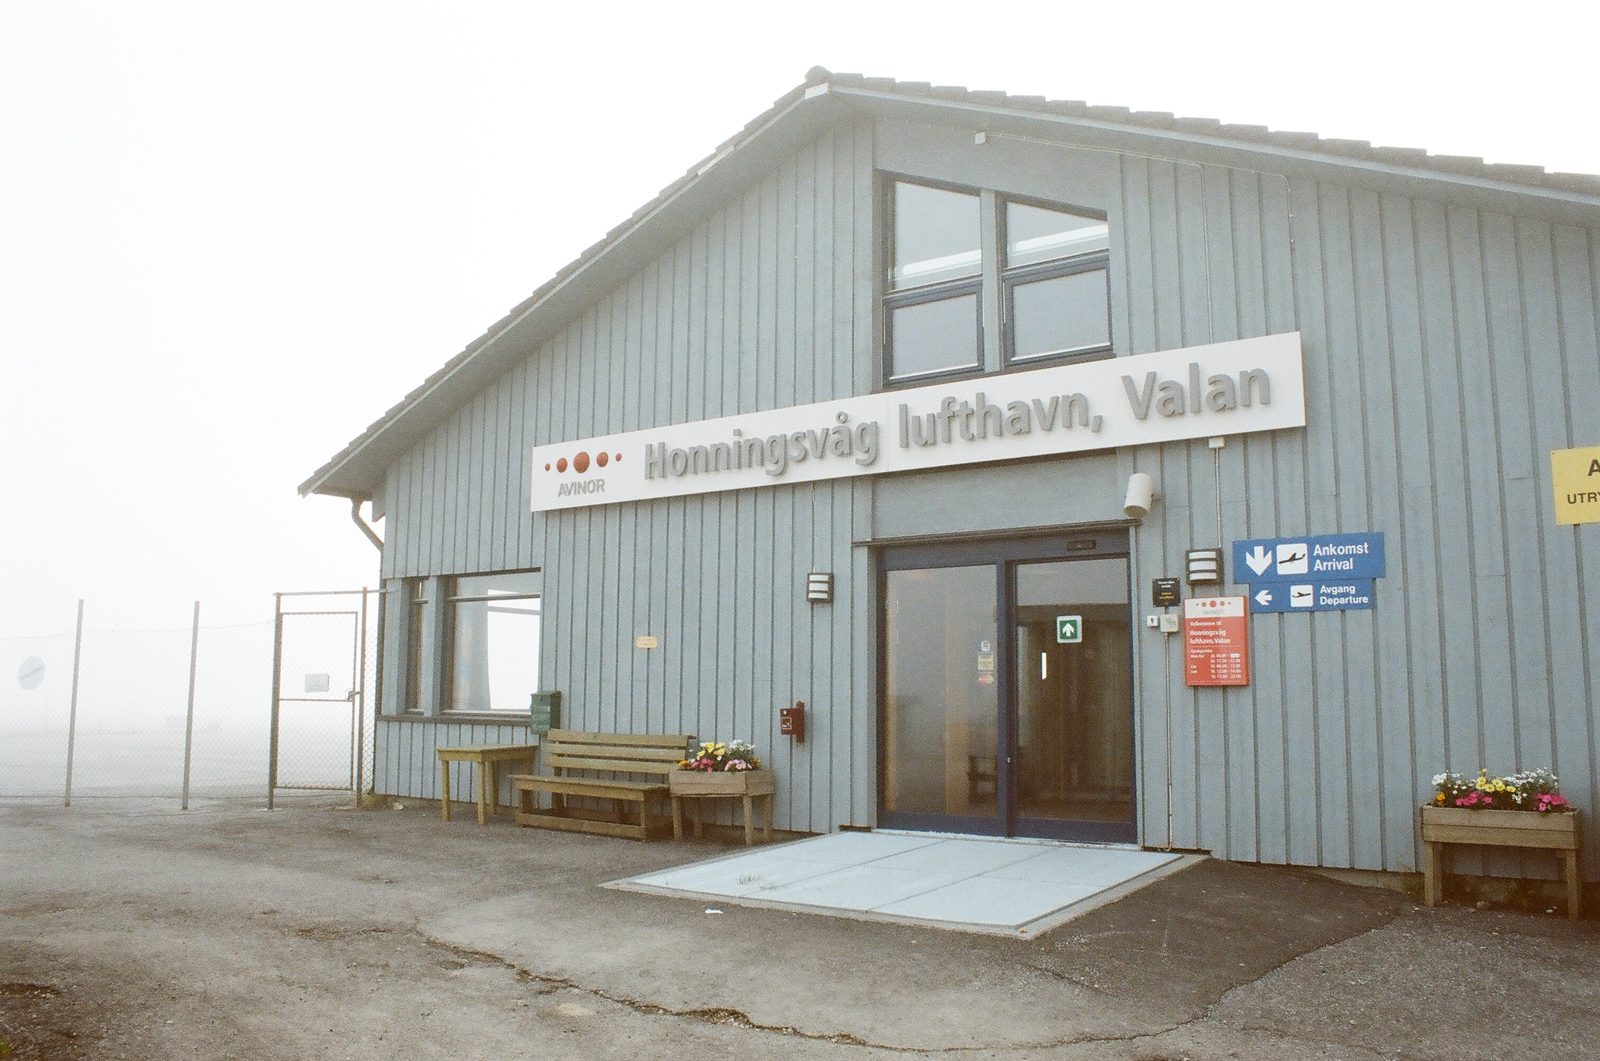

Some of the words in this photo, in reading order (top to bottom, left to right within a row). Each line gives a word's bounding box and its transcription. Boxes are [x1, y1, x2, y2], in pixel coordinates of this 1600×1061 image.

[645, 412, 878, 478] Honningsvåg
[898, 393, 1104, 448] lufthavn,
[1121, 362, 1271, 420] Valan
[558, 479, 605, 498] AVINOR
[1567, 492, 1600, 504] UTR
[1313, 542, 1369, 556] Ankomst
[1314, 558, 1353, 571] Arrival
[1320, 585, 1356, 595] Avgang
[1320, 596, 1369, 606] Departure
